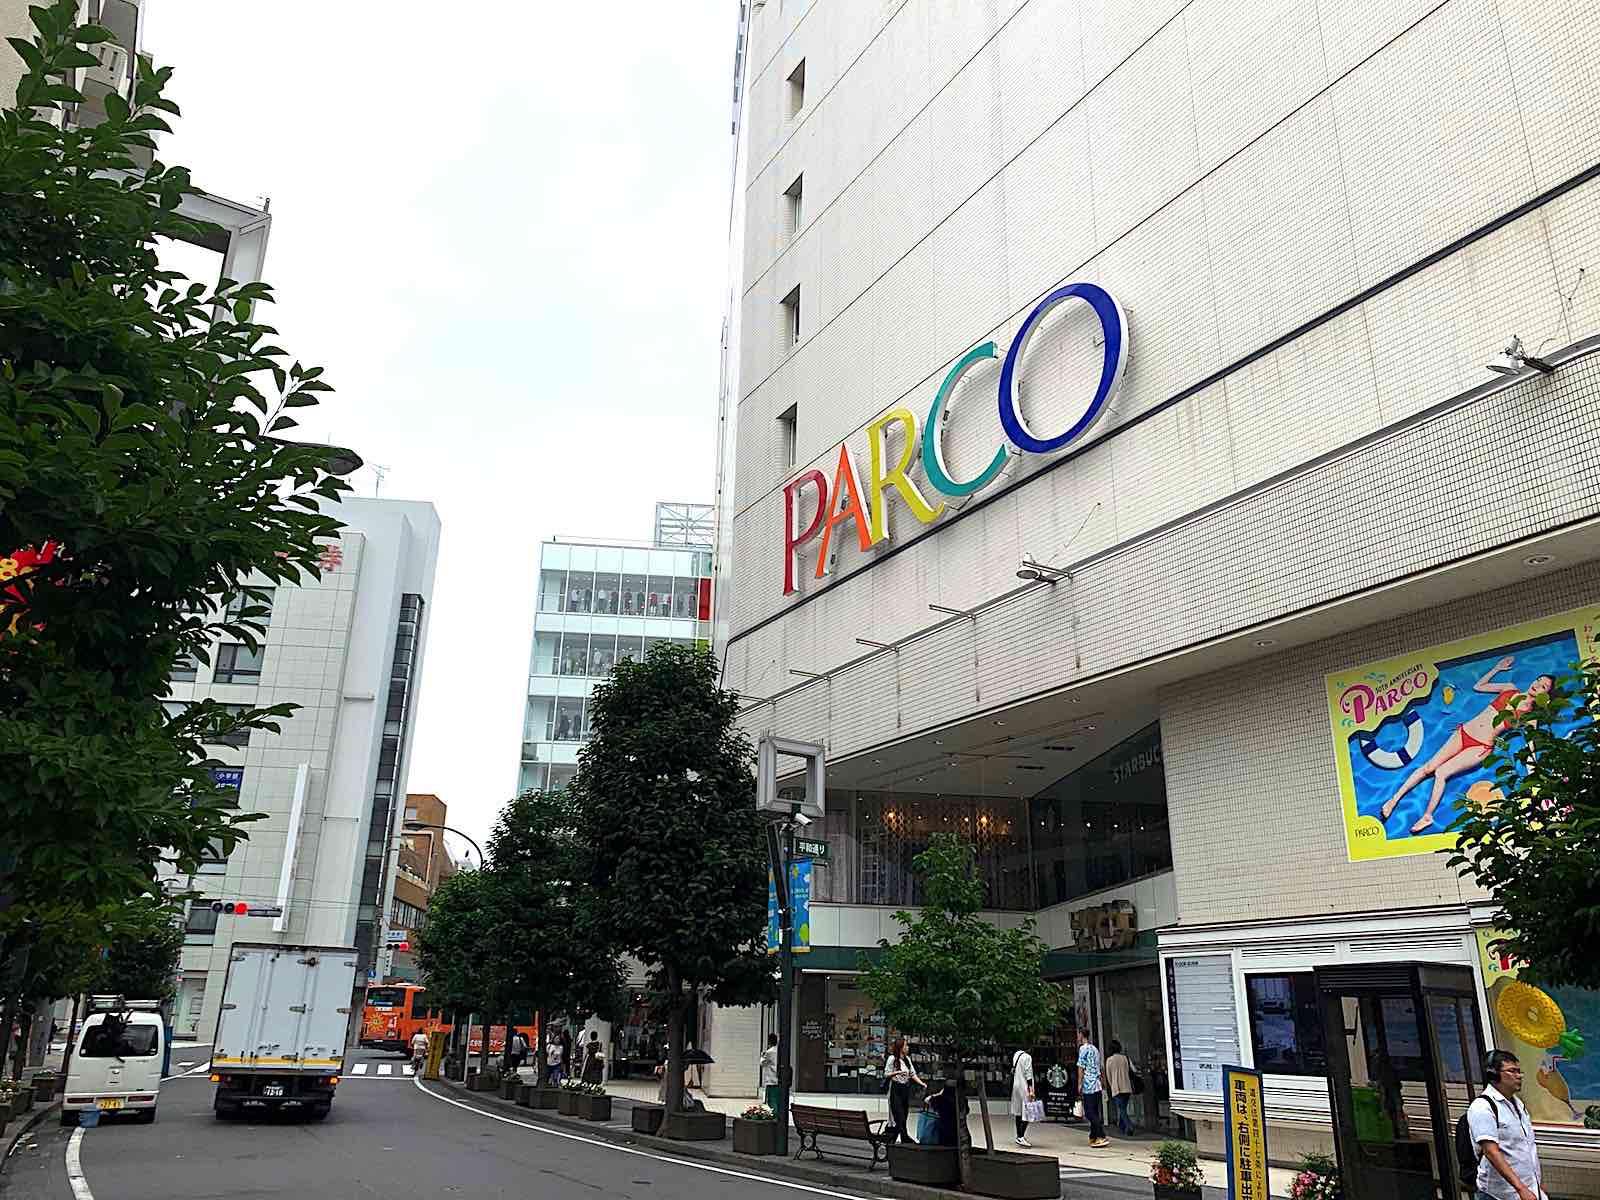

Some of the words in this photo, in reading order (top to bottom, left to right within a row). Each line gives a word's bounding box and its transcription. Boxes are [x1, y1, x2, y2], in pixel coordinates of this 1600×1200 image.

[783, 282, 1130, 597] PARCO
[1339, 671, 1428, 724] PARCO
[799, 842, 825, 857] 平和通り
